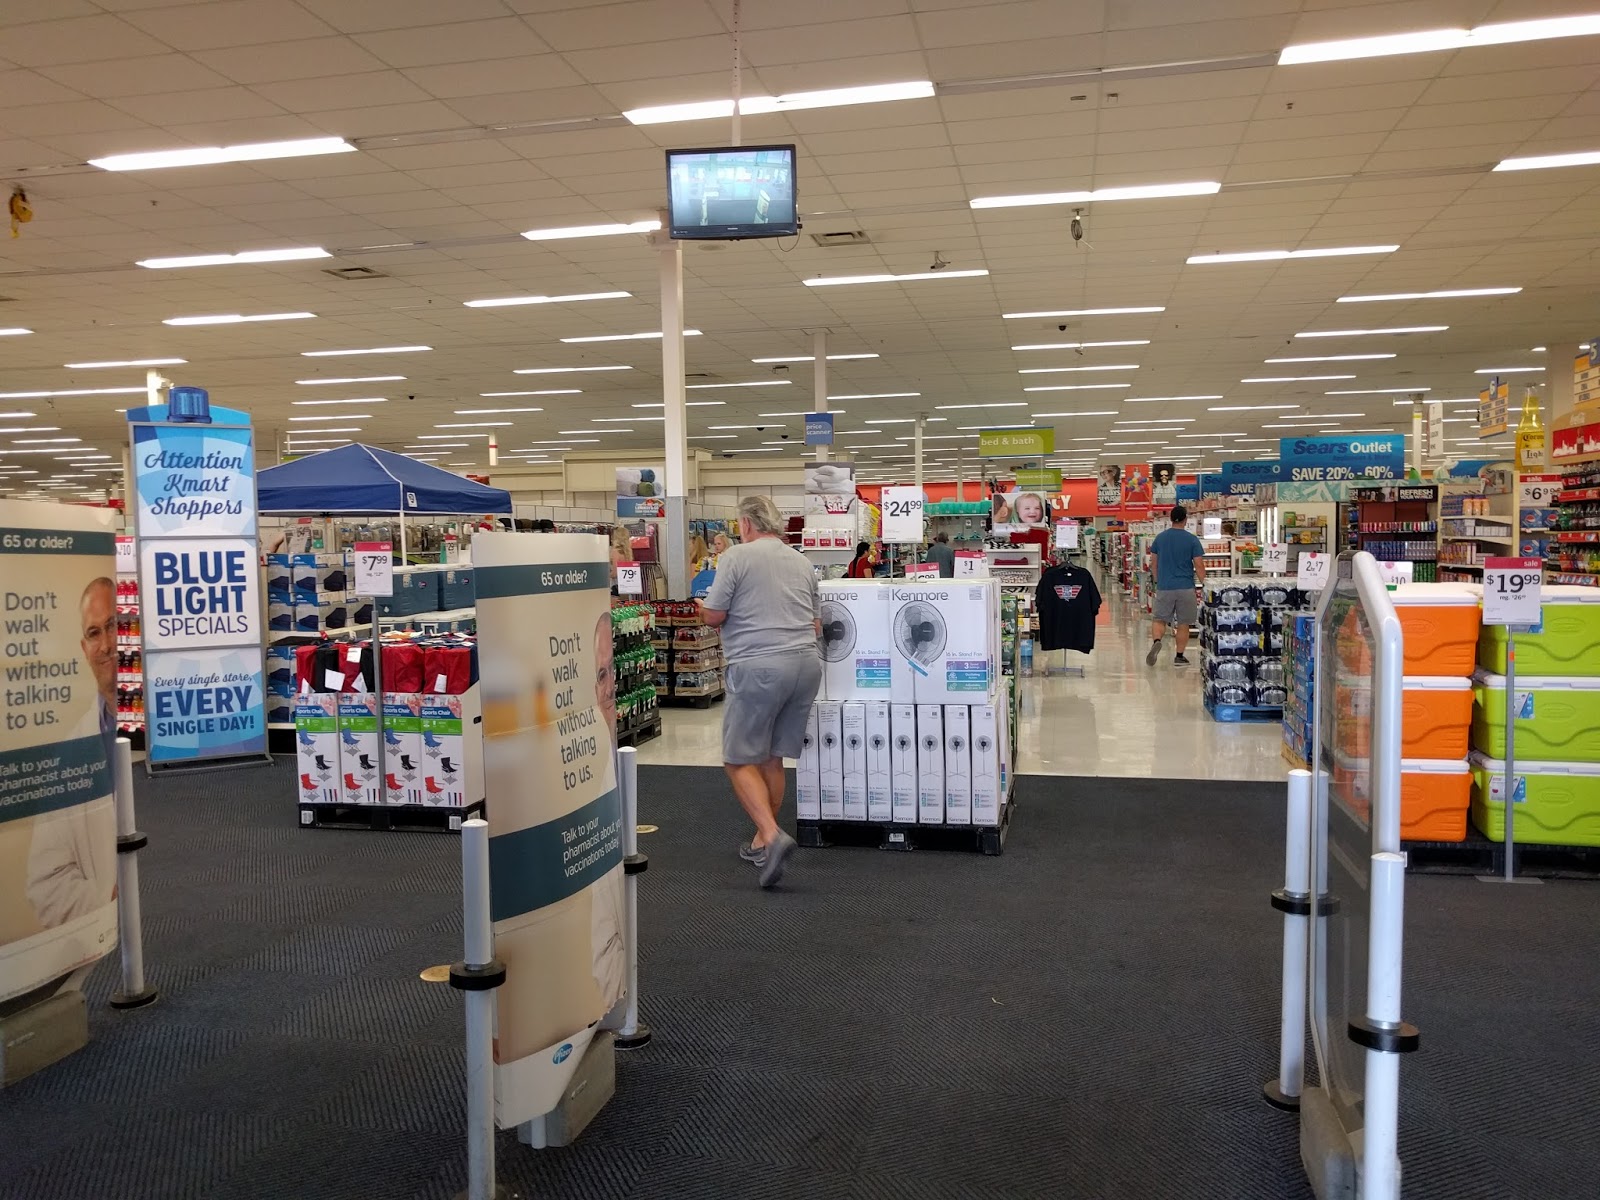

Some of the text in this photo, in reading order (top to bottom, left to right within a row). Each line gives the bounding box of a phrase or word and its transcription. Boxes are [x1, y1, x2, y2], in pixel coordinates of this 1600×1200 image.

[1590, 342, 1598, 360] 5
[981, 437, 1035, 446] bed & bath
[1293, 440, 1392, 455] Sears Outlet
[144, 450, 244, 470] Attention
[1526, 449, 1544, 459] Ligh
[1231, 463, 1271, 475] Sears
[1292, 467, 1324, 481] SAVE
[1326, 466, 1355, 480] 20%
[1364, 465, 1394, 479] 60%
[163, 473, 230, 498] Kmart
[1230, 483, 1254, 494] SAVE
[151, 496, 243, 521] Shoppers
[827, 502, 848, 512] SALE
[3, 534, 74, 549] 65 or older?
[154, 551, 246, 585] BLUE
[541, 570, 588, 586] 65 or older?
[5, 592, 58, 611] Don't
[156, 585, 247, 616] LIGHT
[820, 590, 858, 601] nmore
[892, 589, 949, 601] Kenmore
[5, 614, 50, 635] walk
[158, 615, 249, 637] SPECIALS
[5, 638, 39, 657] out
[549, 632, 581, 657] Don't
[6, 658, 79, 682] without
[552, 658, 579, 684] walk
[872, 659, 878, 667] 3
[154, 672, 253, 690] Every single store,
[6, 684, 71, 707] talking
[155, 685, 252, 718] EVERY
[555, 686, 573, 709] out
[6, 710, 59, 730] to us.
[156, 715, 255, 737] SINGLE DAY!
[557, 705, 596, 736] without
[561, 736, 596, 764] talking
[21, 761, 34, 772] to
[36, 757, 61, 772] your
[60, 763, 89, 779] about
[89, 760, 107, 774] your
[563, 764, 594, 791] to us.
[561, 817, 599, 844] Talk to your
[563, 831, 600, 863] pharmacist
[601, 821, 615, 840] about
[564, 846, 605, 877] vaccinations
